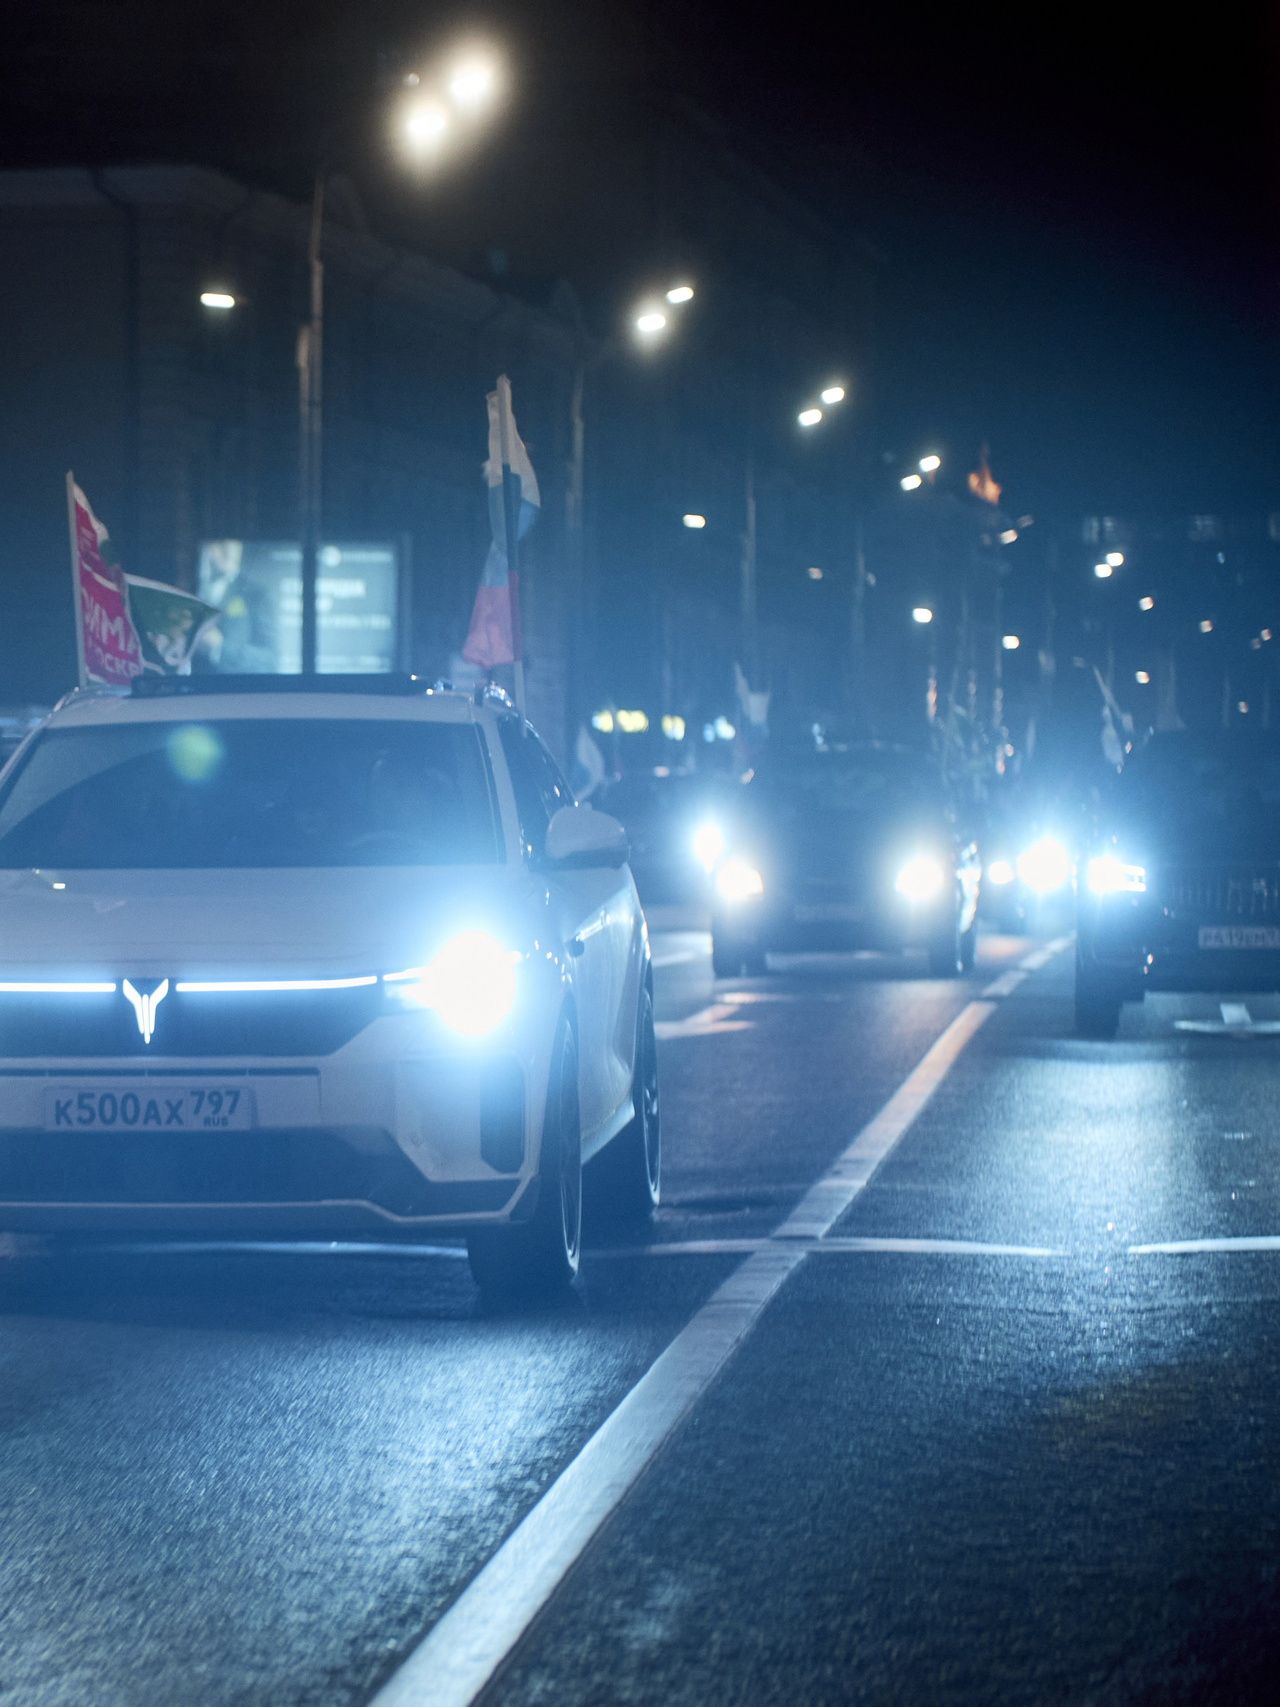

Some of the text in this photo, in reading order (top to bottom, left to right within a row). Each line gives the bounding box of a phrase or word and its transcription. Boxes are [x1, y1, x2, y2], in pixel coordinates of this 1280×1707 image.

[55, 1089, 241, 1126] К500АХ 797
[203, 1115, 229, 1127] RUS
